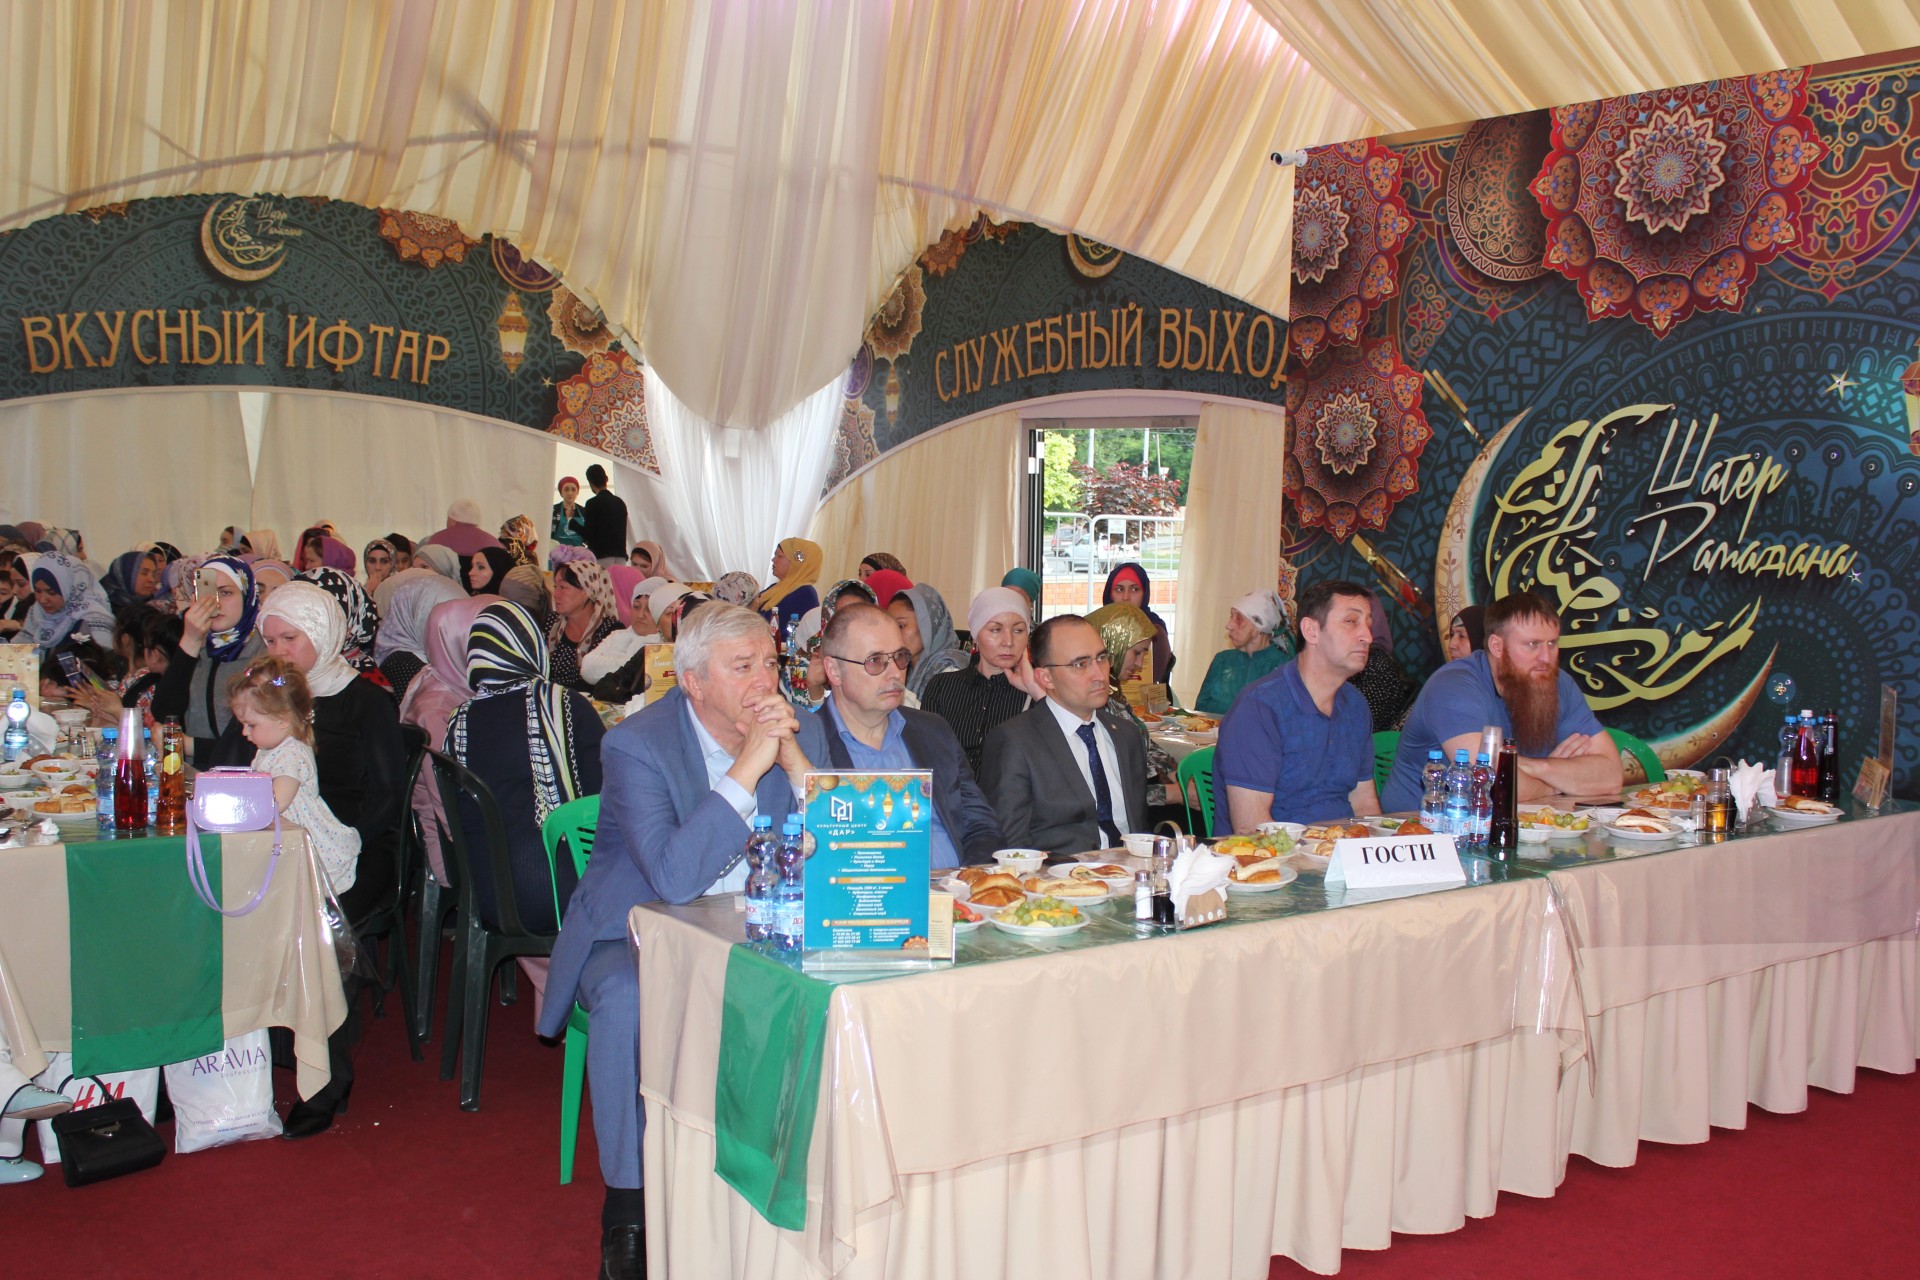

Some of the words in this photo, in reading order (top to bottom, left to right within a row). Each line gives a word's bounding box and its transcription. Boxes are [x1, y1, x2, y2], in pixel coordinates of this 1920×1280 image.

[22, 306, 266, 375] ВКУСНЫЙ
[286, 315, 451, 386] ИФТАР
[935, 302, 1143, 402] СЛУЖЕБНЫЙ
[1647, 412, 1790, 545] Шатер
[1633, 501, 1859, 582] Рамадана
[1361, 843, 1436, 864] ГОСТИ
[73, 1081, 125, 1112] HM
[192, 1046, 267, 1077] ARAVIA
